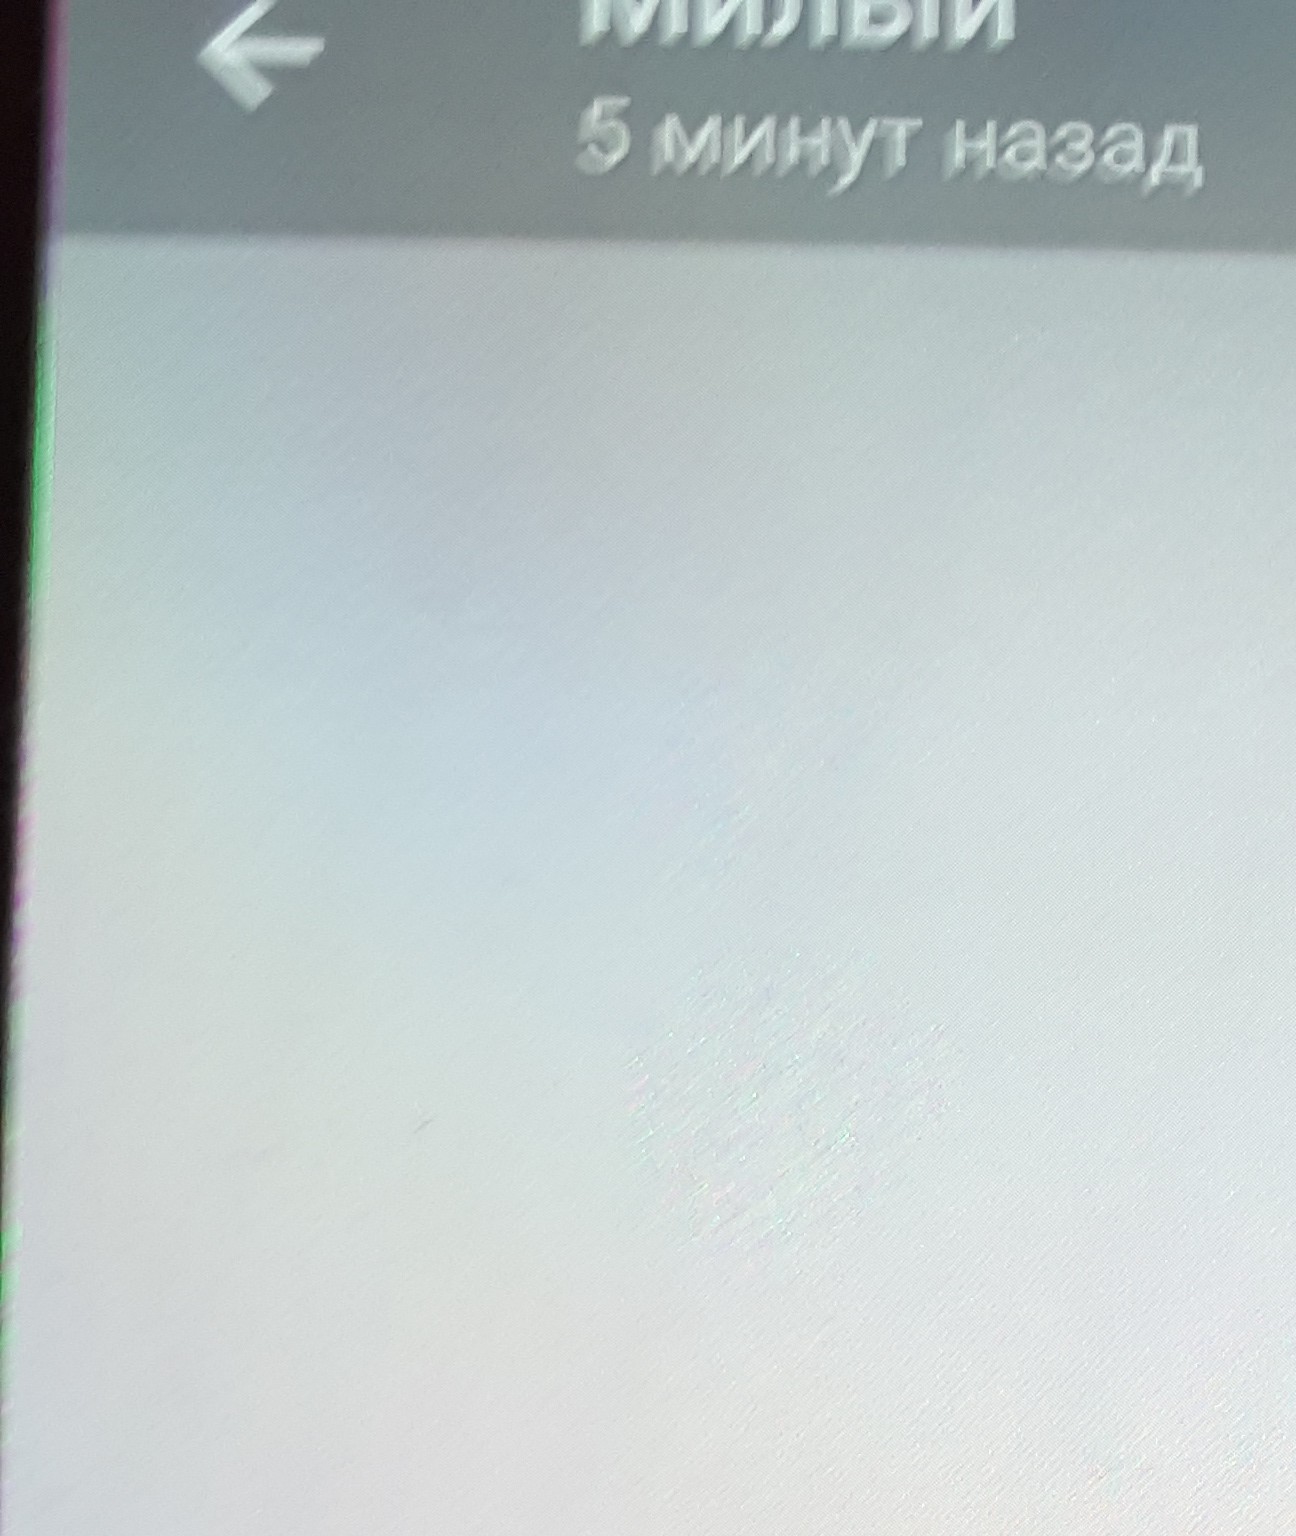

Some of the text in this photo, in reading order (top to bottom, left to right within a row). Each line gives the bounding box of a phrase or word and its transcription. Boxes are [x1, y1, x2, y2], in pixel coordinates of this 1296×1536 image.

[576, 96, 1204, 197] 5 минут назад
